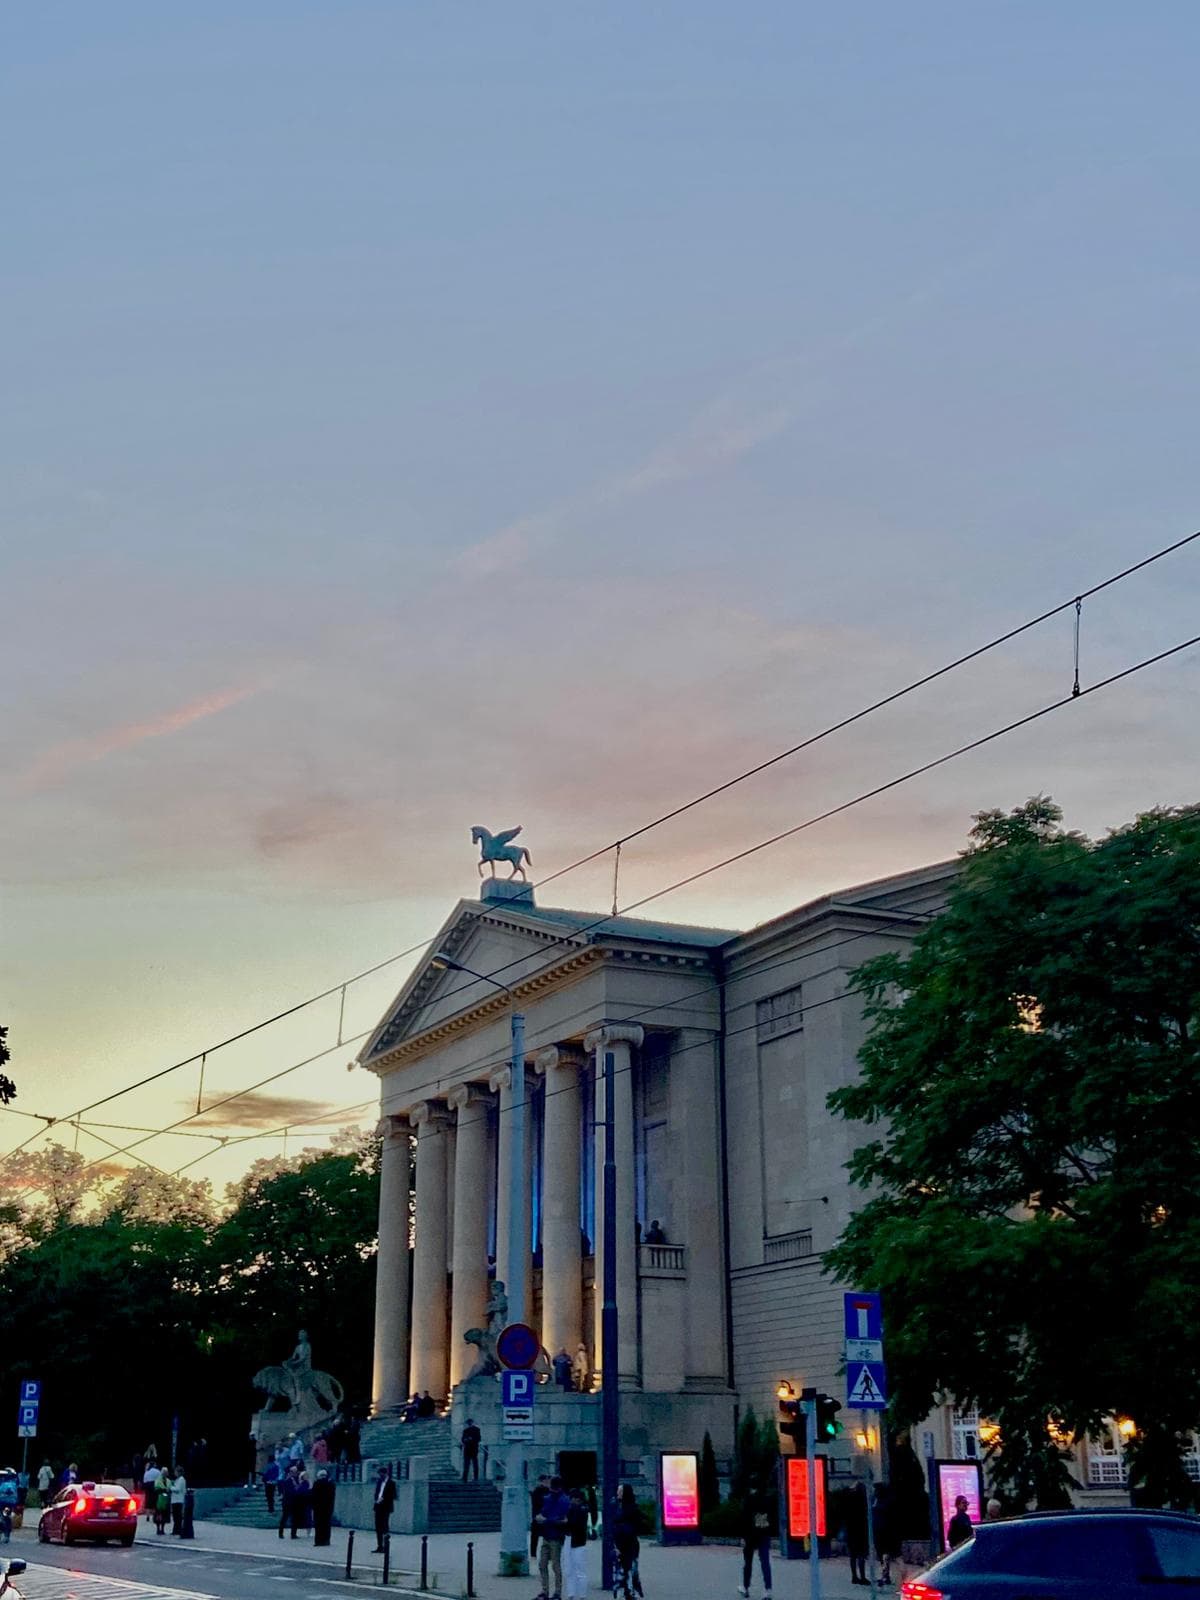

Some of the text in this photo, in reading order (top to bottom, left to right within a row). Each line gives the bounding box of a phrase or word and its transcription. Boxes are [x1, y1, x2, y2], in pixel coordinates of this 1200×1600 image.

[26, 1383, 37, 1398] P
[510, 1375, 527, 1401] P
[24, 1409, 34, 1423] P
